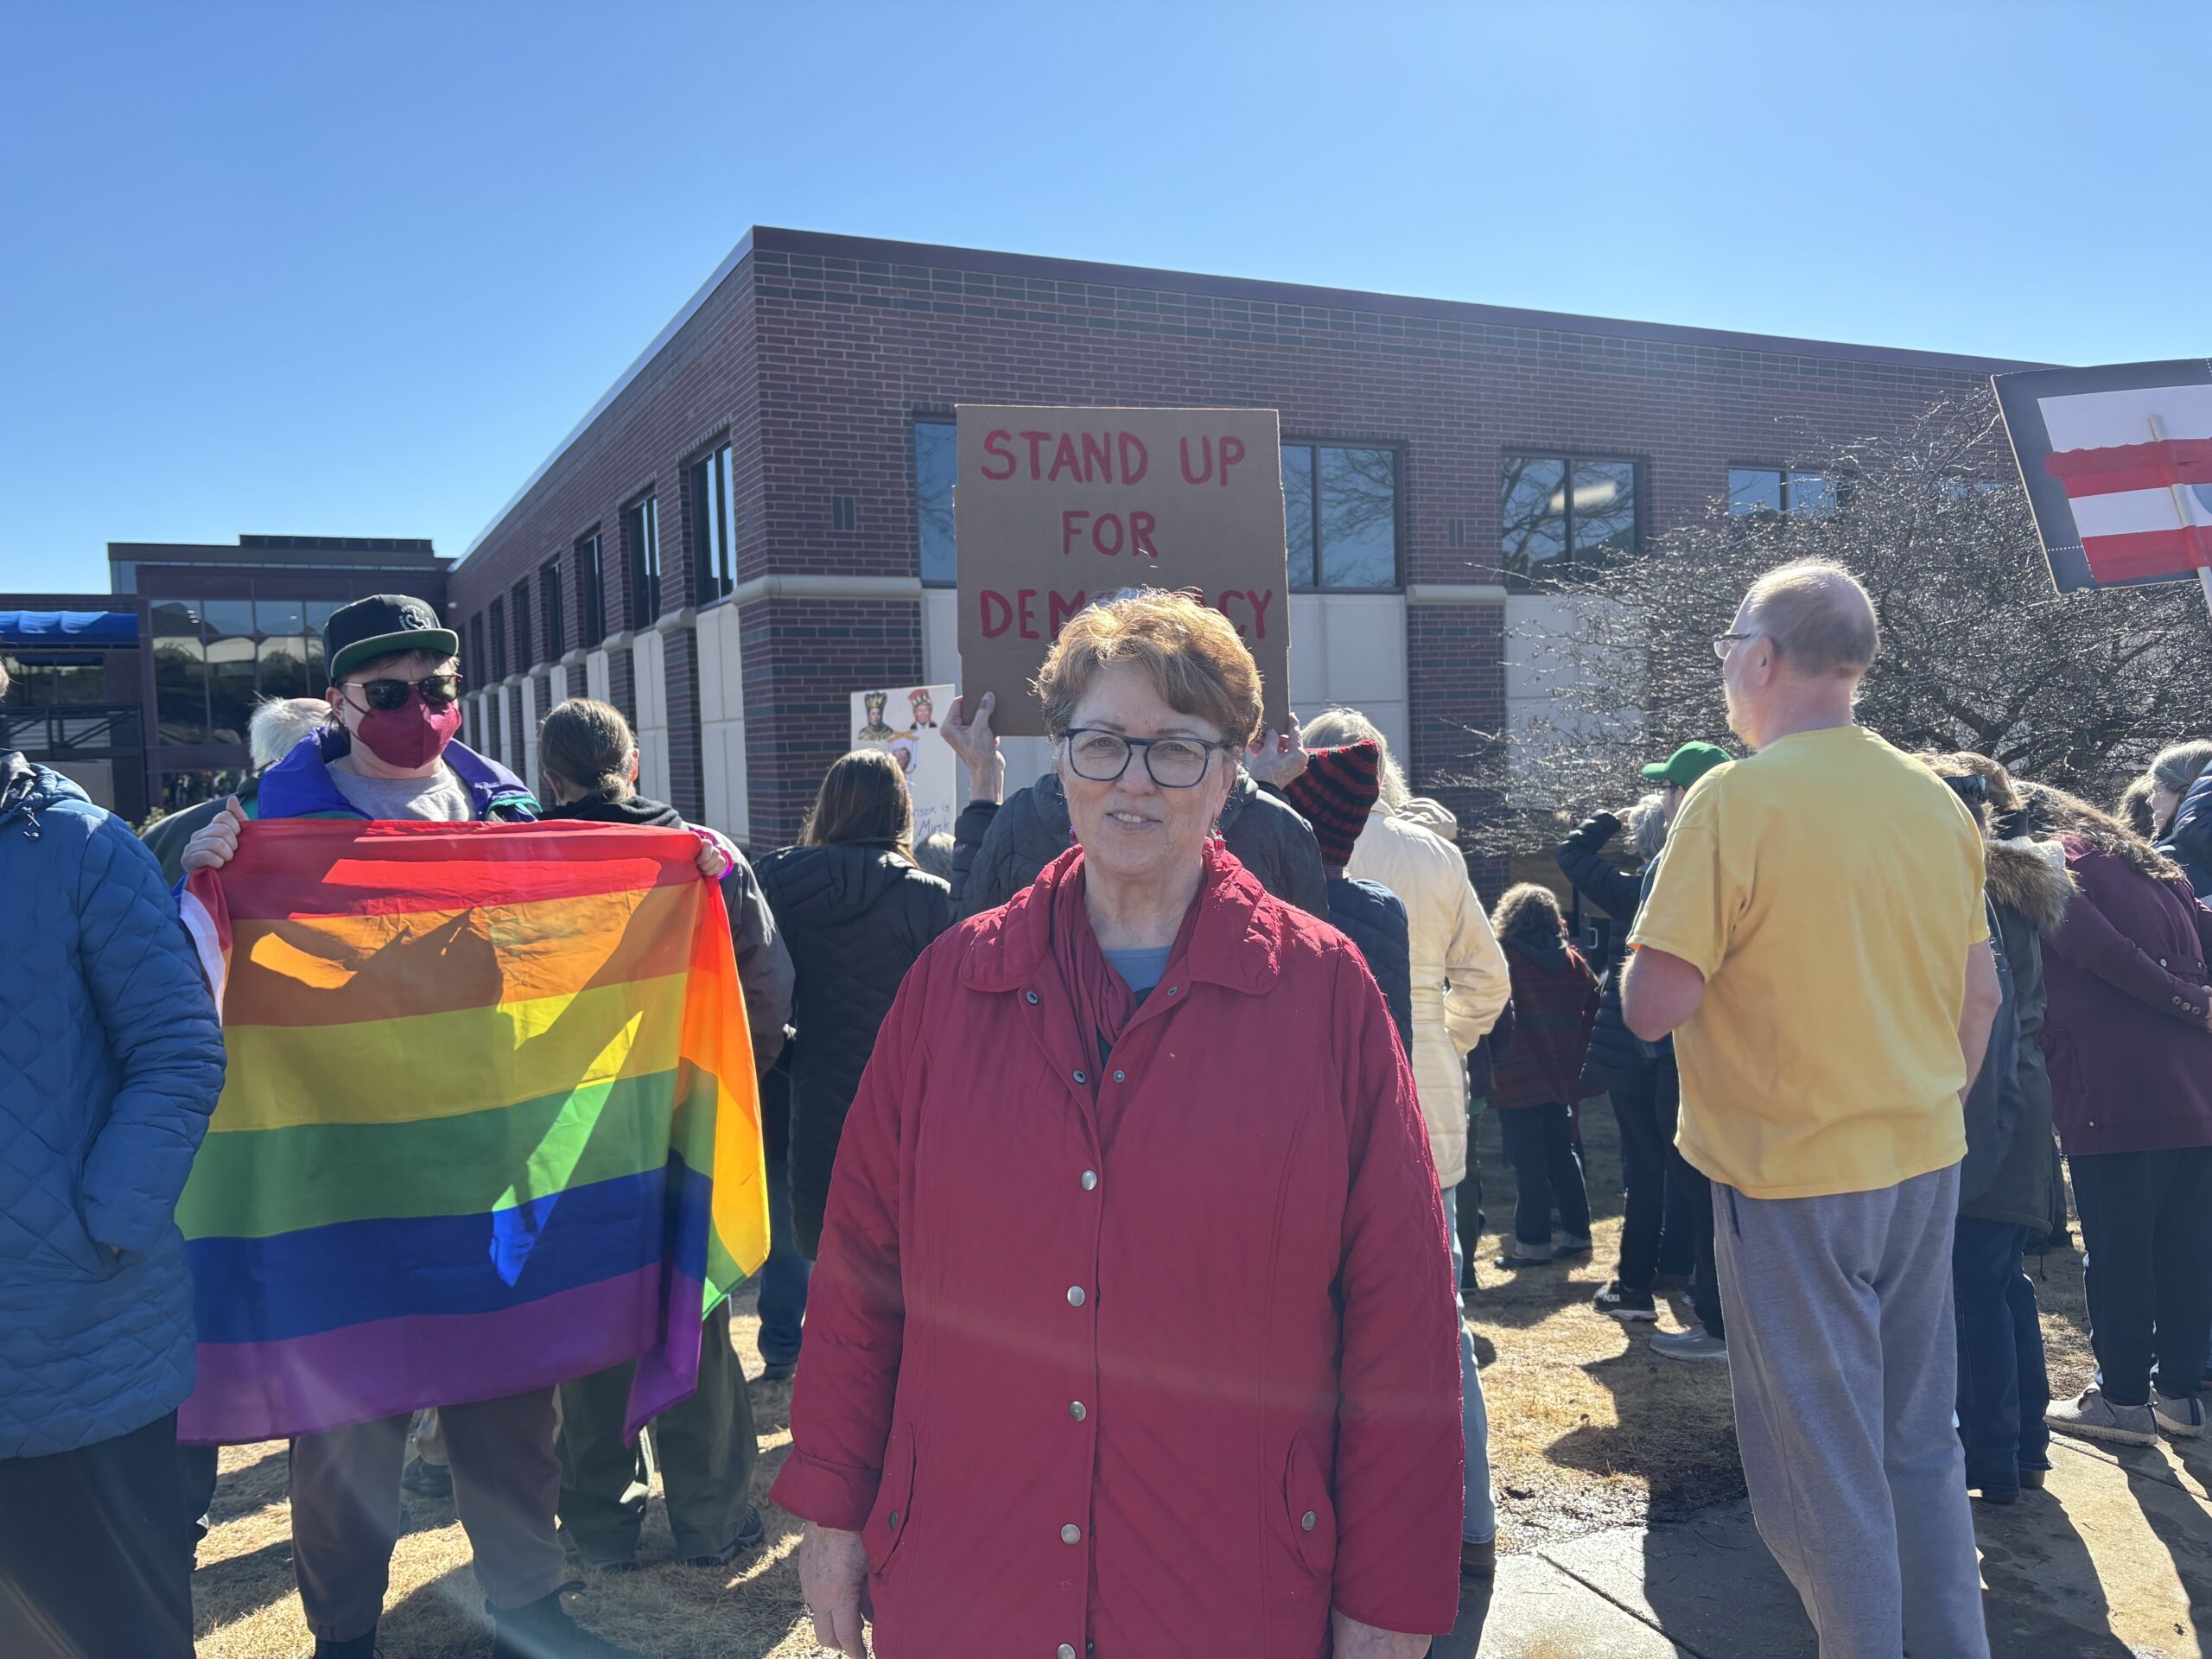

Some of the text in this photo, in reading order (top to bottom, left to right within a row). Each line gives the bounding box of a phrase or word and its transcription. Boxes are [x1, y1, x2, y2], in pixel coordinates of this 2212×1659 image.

[981, 429, 1245, 486] STAND UP
[1062, 510, 1159, 558] FOR
[980, 588, 1273, 639] DEMCY
[918, 818, 950, 837] Musk
